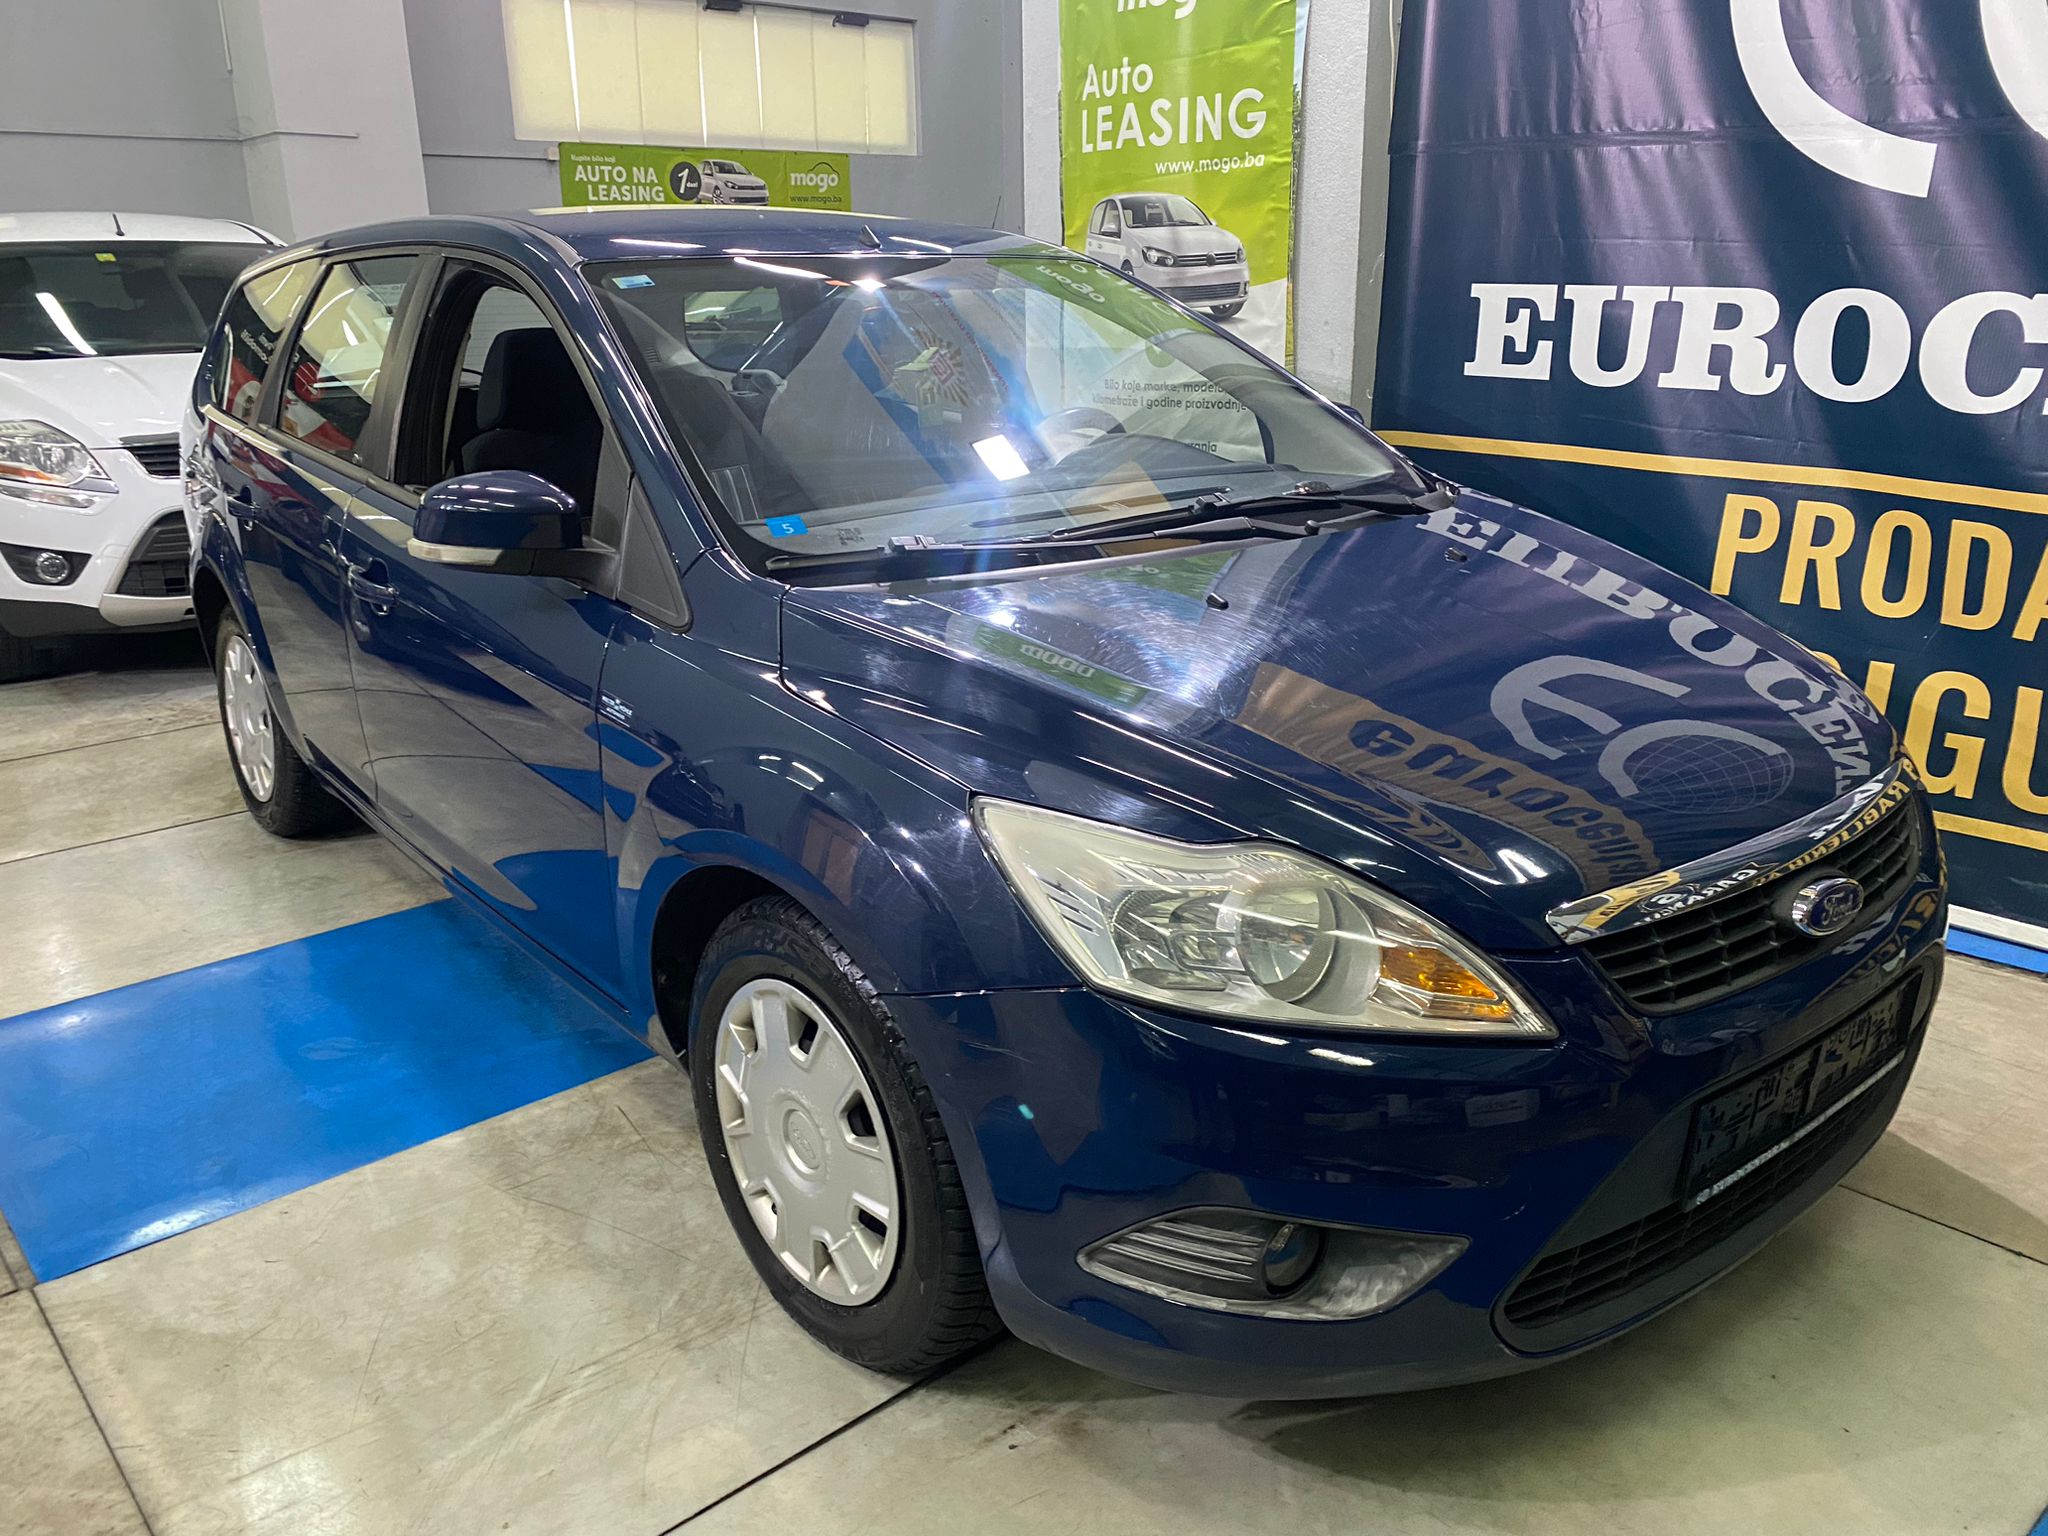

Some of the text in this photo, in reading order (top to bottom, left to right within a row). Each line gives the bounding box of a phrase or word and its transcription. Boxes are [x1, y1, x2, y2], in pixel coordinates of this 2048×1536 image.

[1081, 56, 1154, 101] Auto
[1081, 87, 1267, 154] LEASING
[1154, 151, 1265, 175] www.mogo.ba
[574, 164, 659, 184] AUTO NA
[789, 172, 839, 193] mogo
[587, 184, 665, 202] LEASING
[1464, 283, 2048, 415] EUROC
[1121, 379, 1141, 394] koje
[1143, 381, 1180, 393] marke,
[1146, 396, 1182, 410] godine
